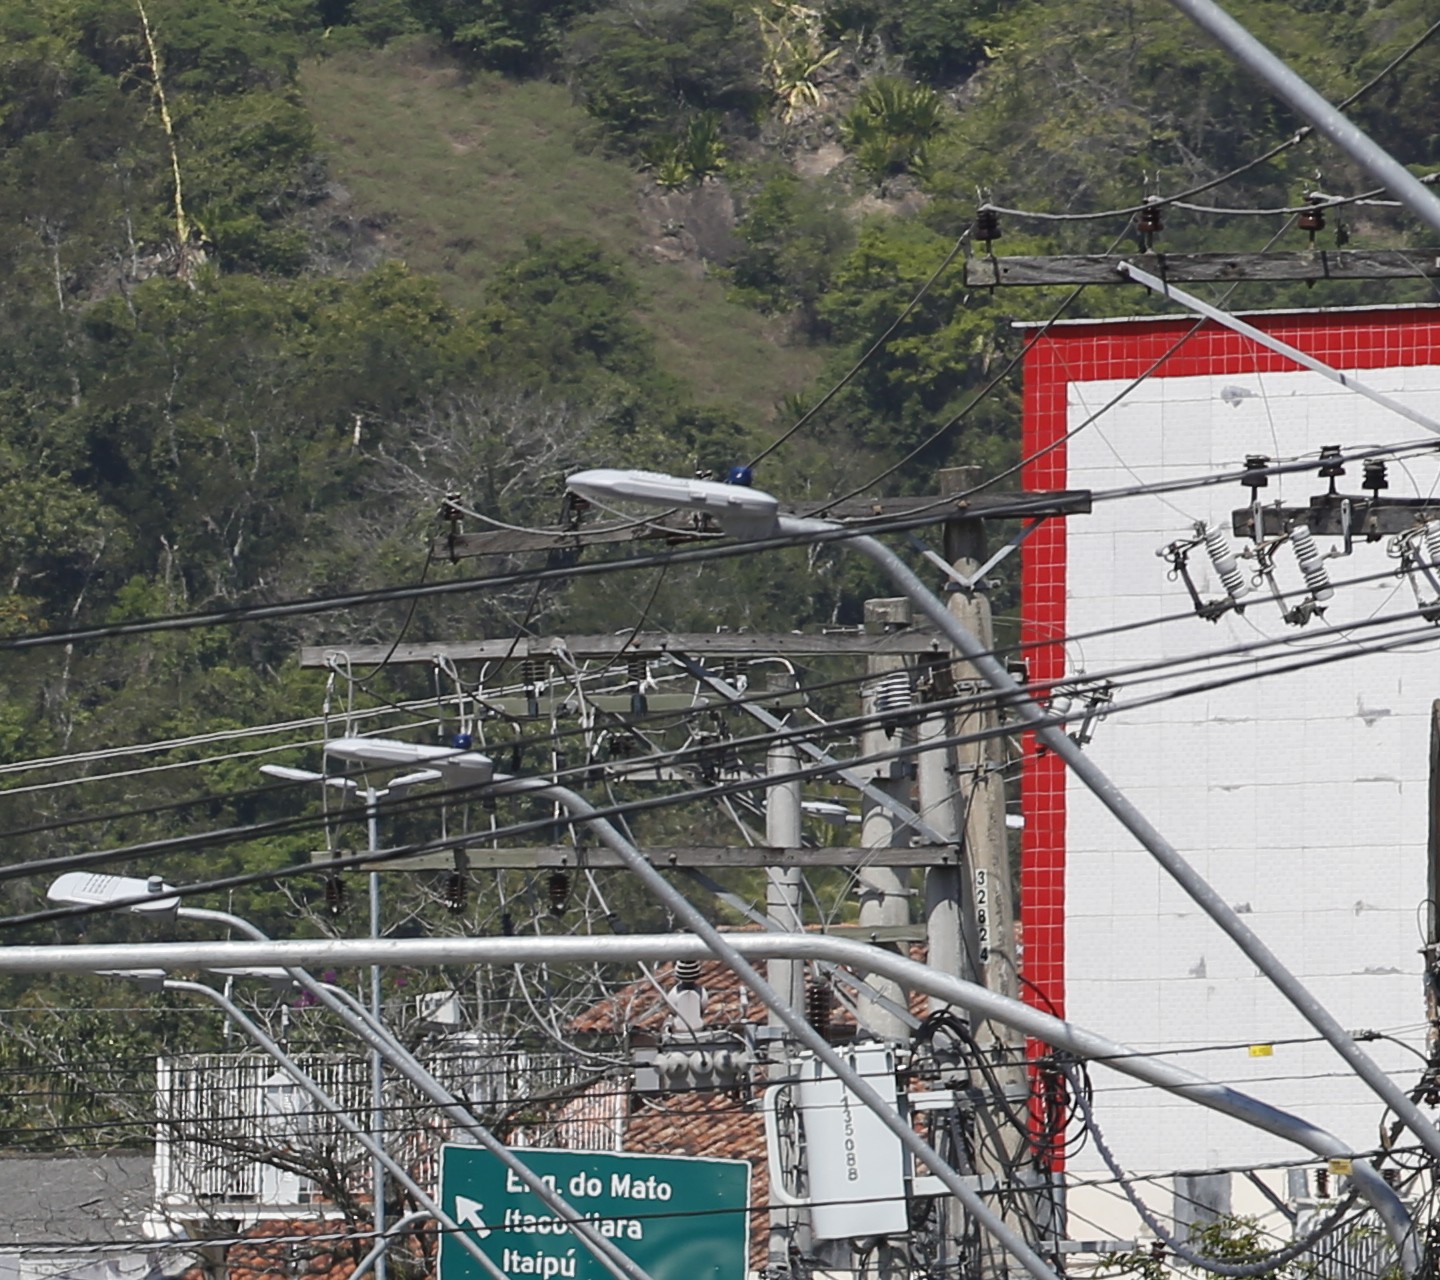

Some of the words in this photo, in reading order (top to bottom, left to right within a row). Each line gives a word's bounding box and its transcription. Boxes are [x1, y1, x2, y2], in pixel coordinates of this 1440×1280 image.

[977, 870, 988, 961] 32824
[569, 1171, 603, 1198] do
[610, 1173, 673, 1201] Mato
[502, 1247, 577, 1280] Itaipú
